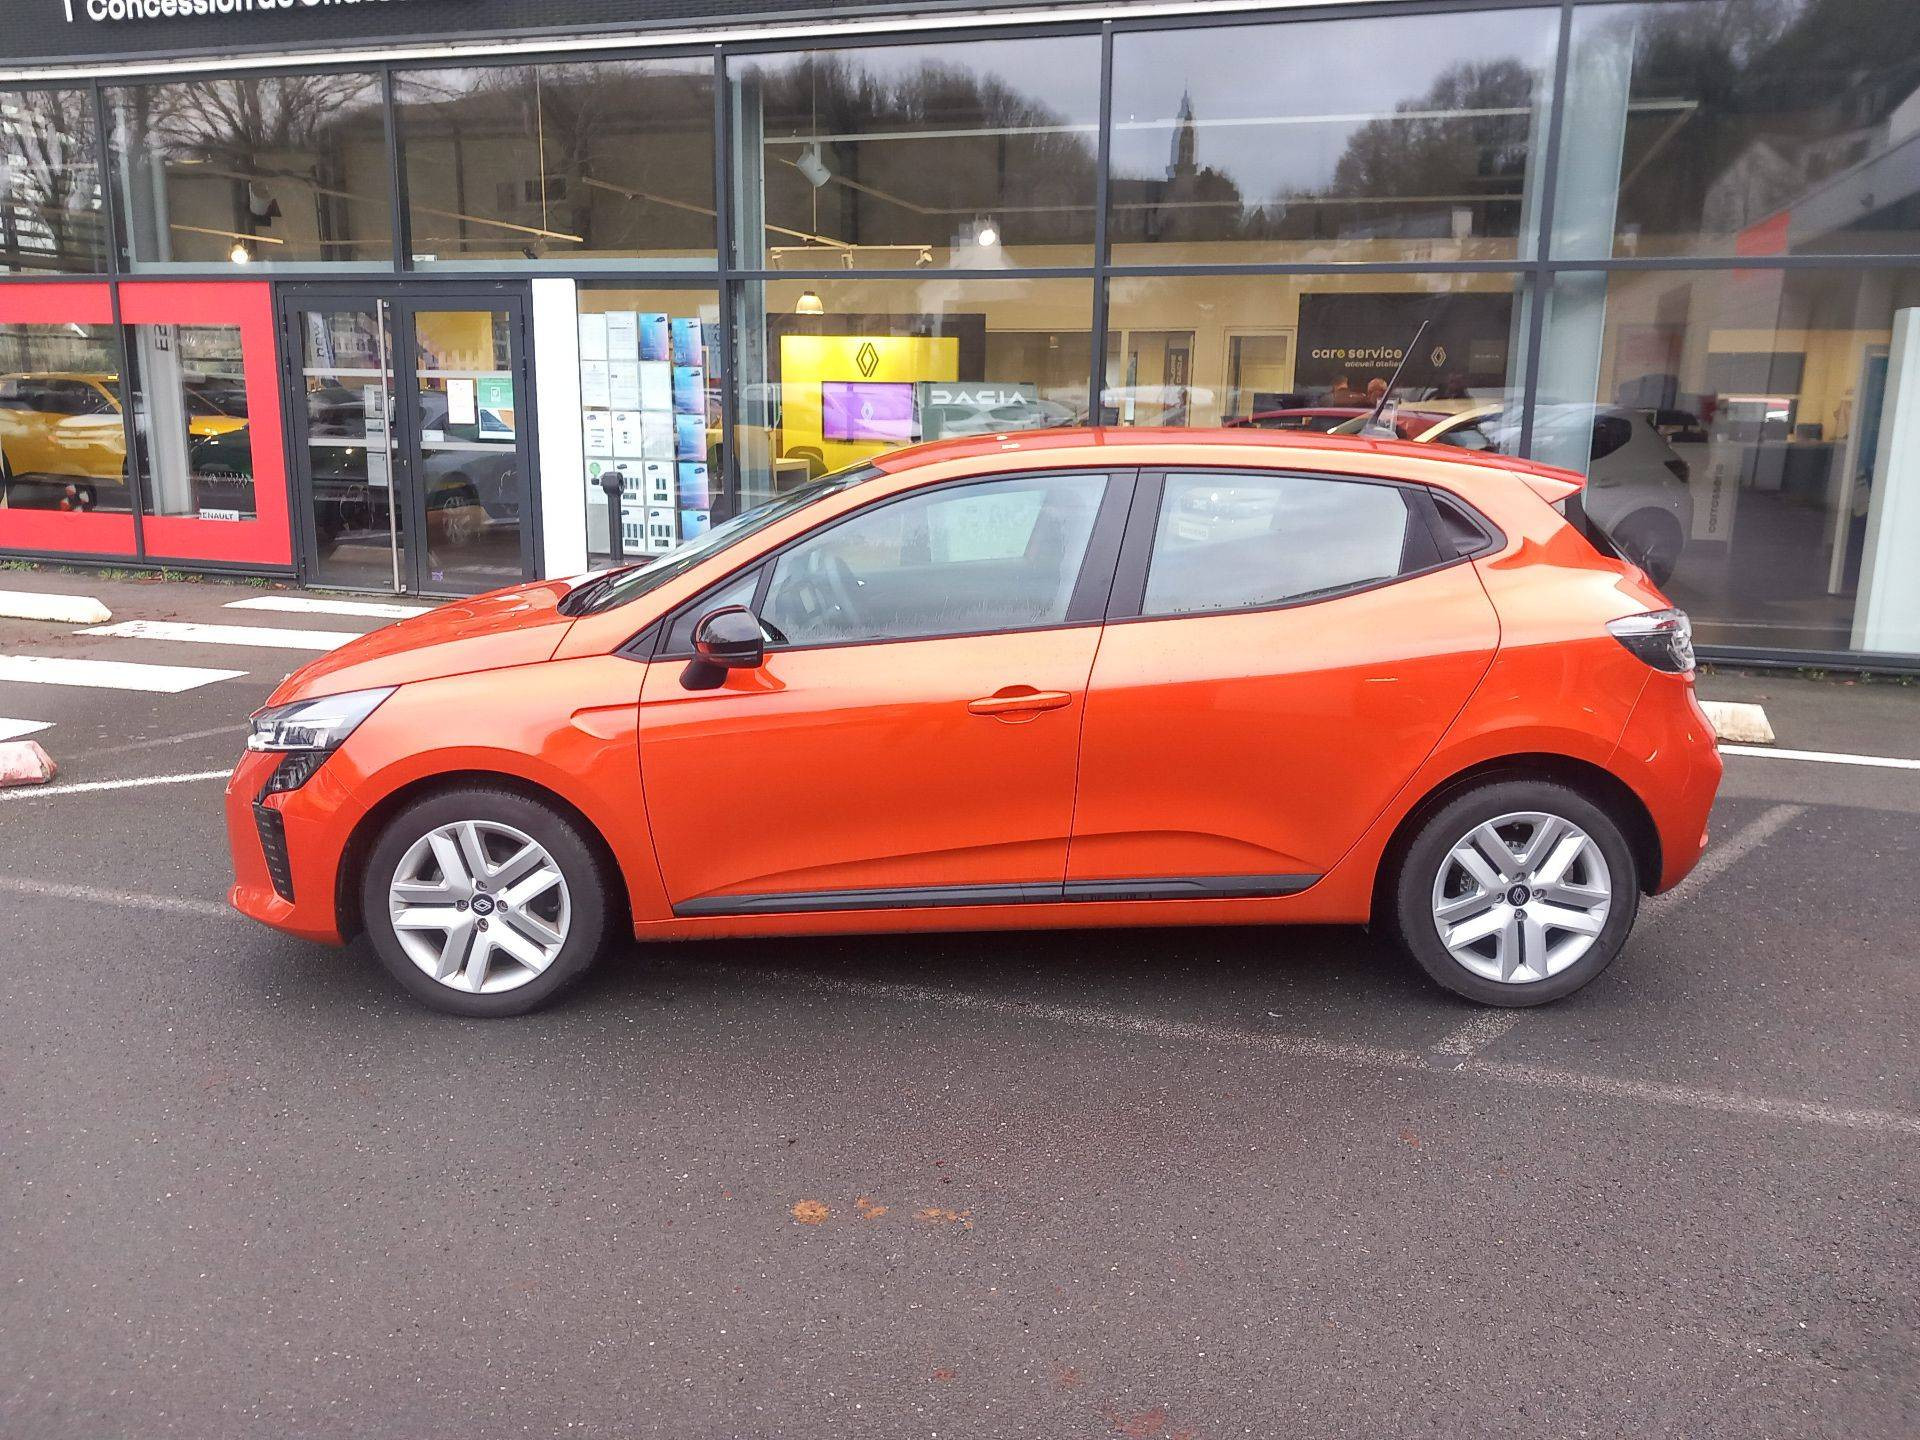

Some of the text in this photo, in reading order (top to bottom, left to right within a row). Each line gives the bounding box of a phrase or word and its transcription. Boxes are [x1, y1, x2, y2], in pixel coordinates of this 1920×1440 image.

[1311, 346, 1403, 359] care service
[931, 390, 1028, 405] DACIA
